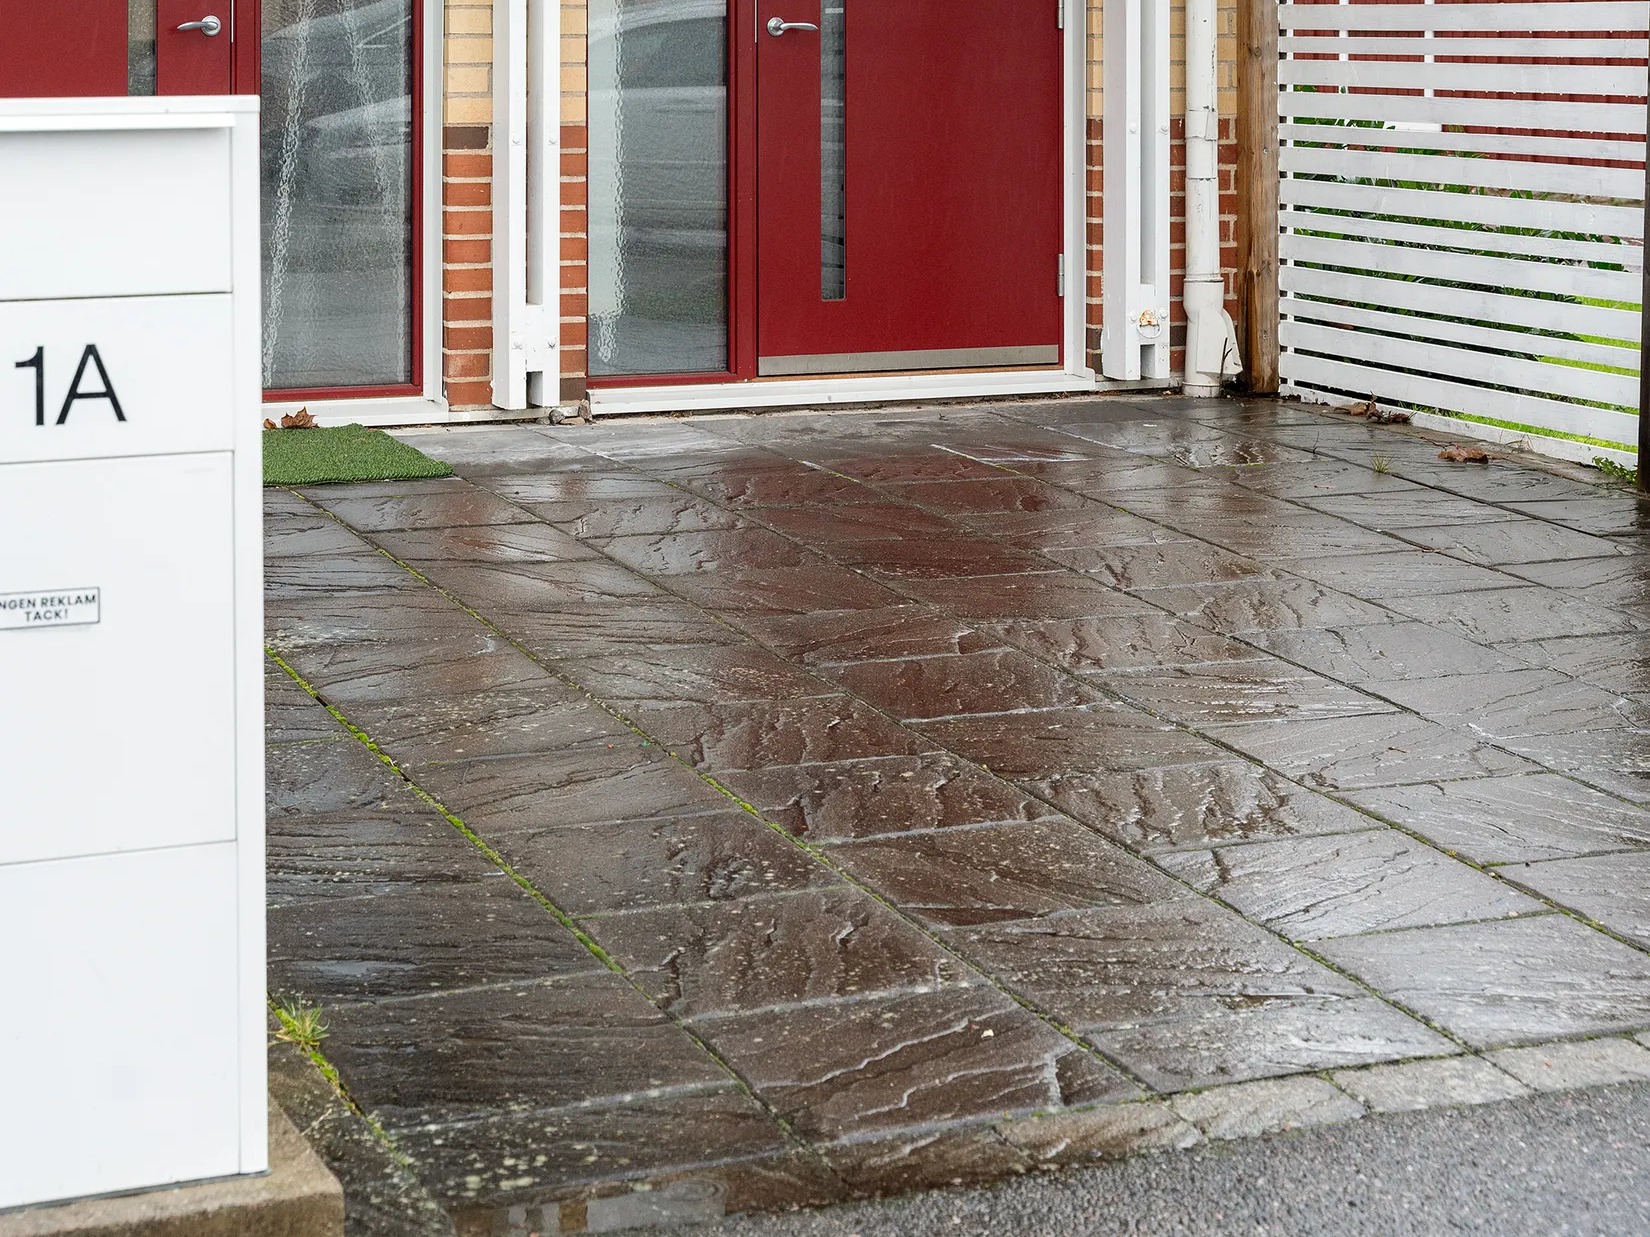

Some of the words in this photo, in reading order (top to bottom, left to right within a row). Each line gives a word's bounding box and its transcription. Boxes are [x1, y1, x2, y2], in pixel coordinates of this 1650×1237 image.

[15, 343, 127, 426] 1A
[41, 594, 96, 608] REKLAM
[25, 609, 68, 622] TACK!
